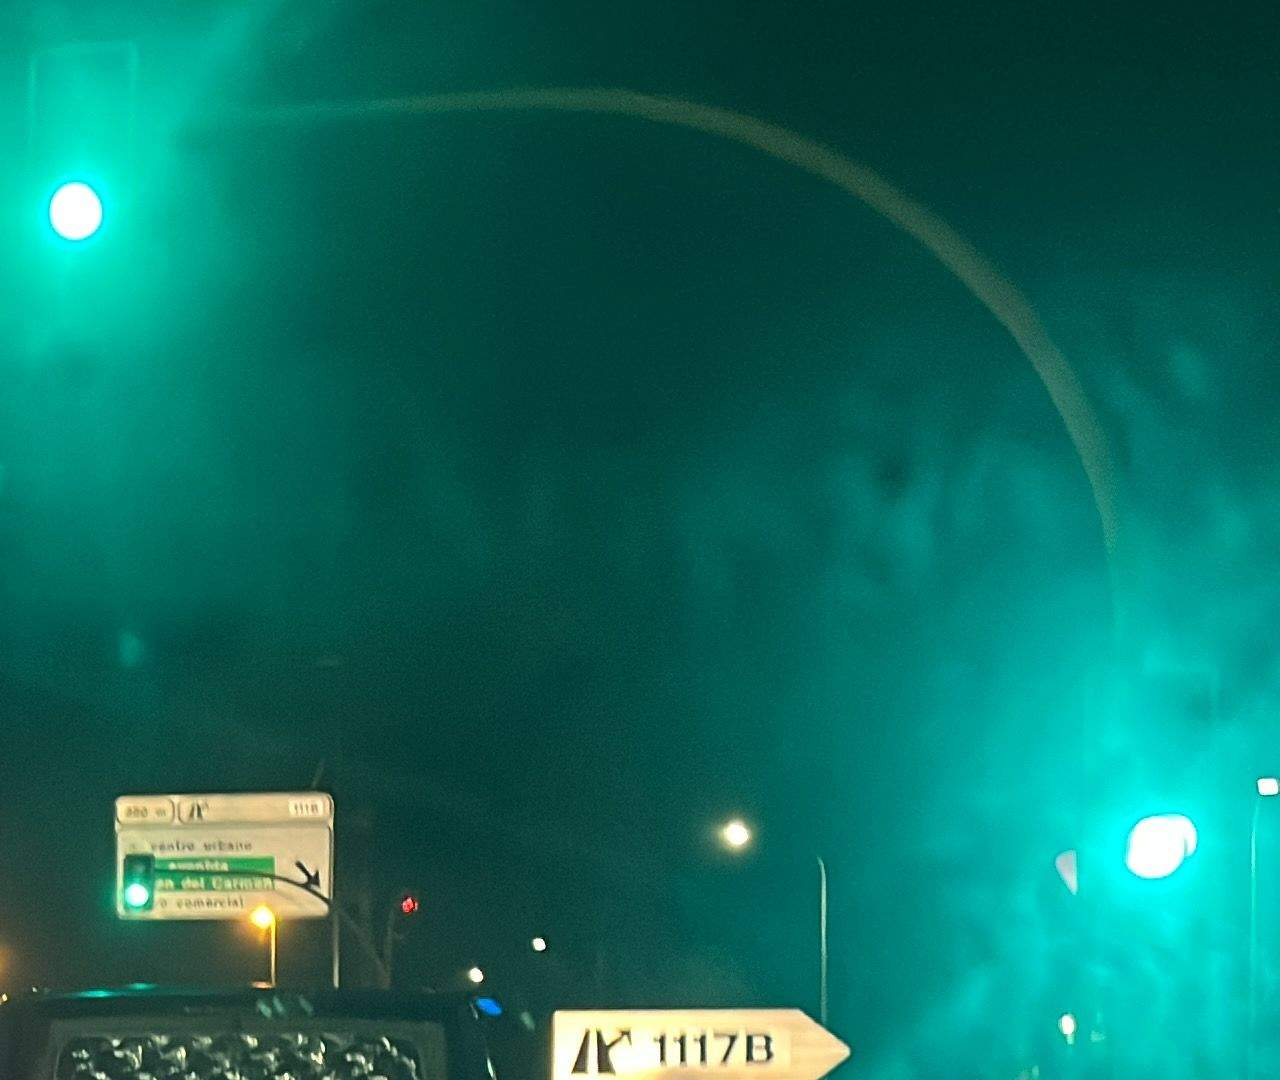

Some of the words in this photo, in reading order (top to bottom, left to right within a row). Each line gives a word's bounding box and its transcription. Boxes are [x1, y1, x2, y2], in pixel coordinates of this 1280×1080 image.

[203, 839, 253, 852] urbano
[181, 876, 205, 890] del
[176, 897, 245, 909] comercial
[653, 1031, 774, 1067] 1117B
